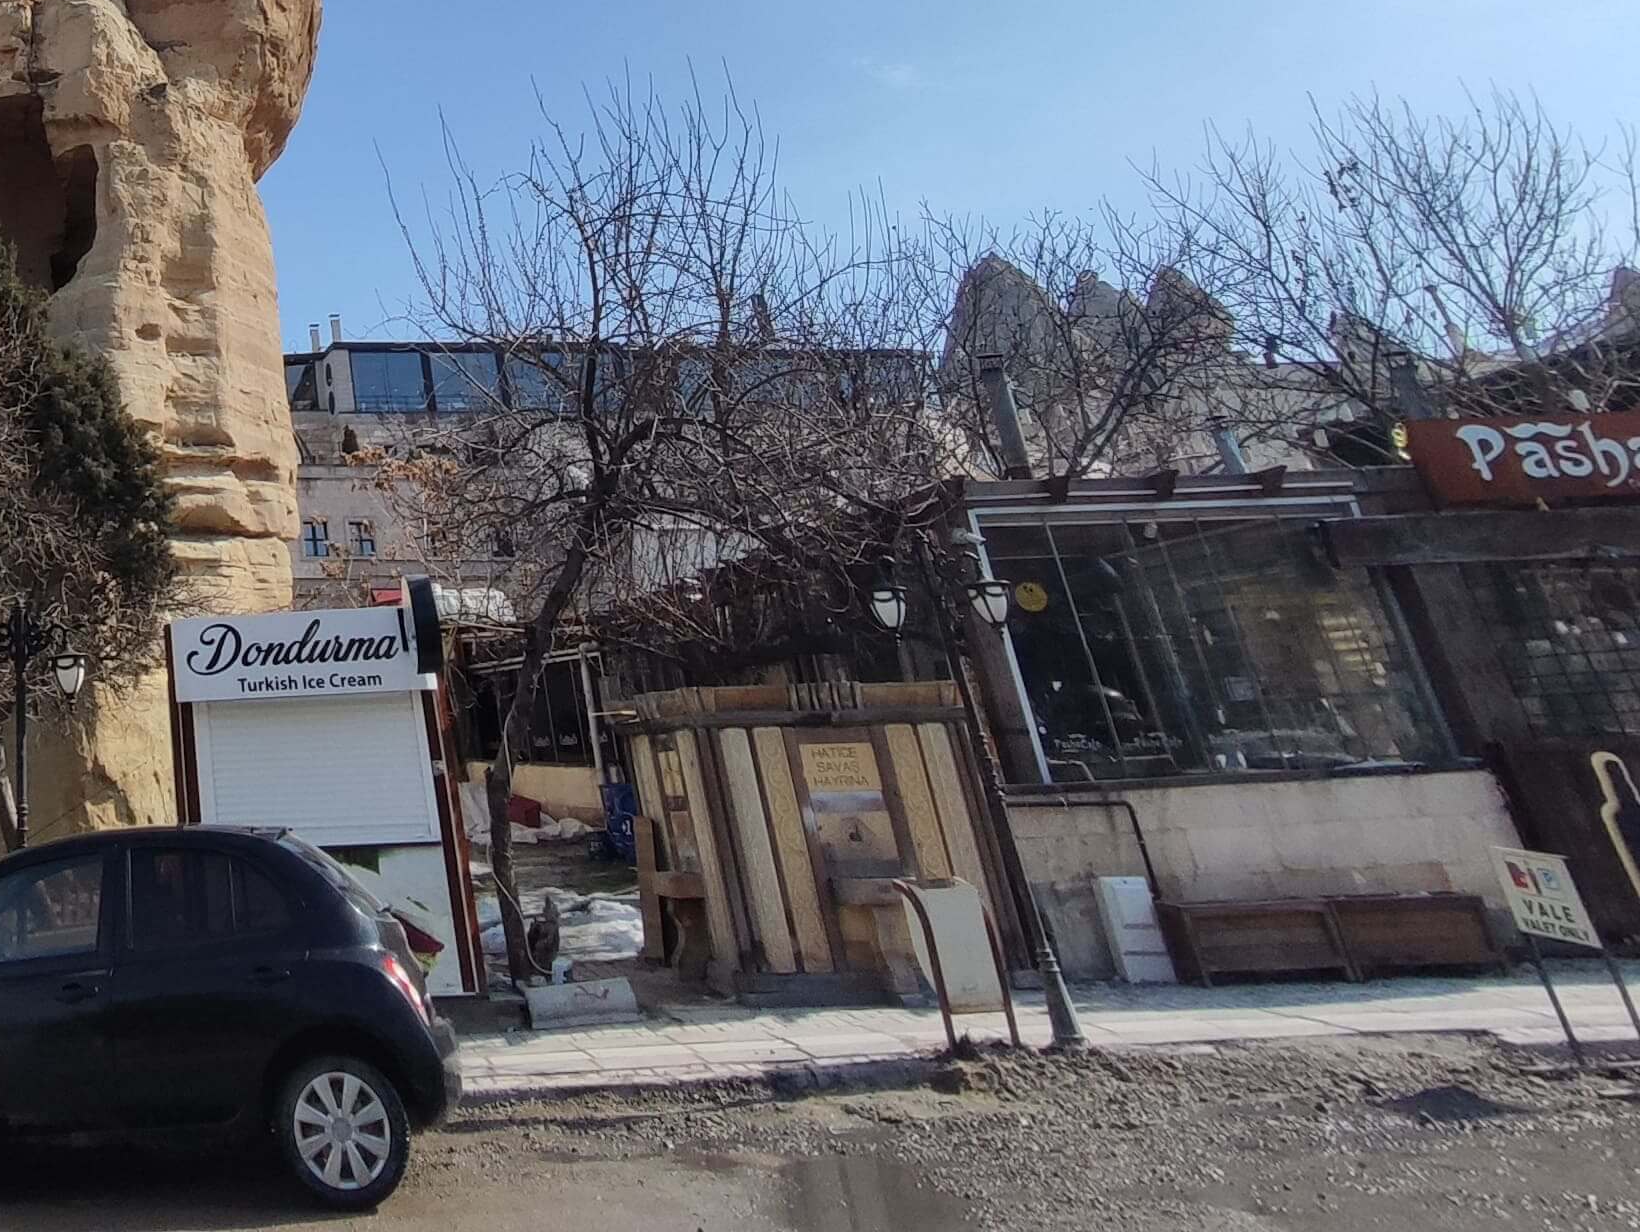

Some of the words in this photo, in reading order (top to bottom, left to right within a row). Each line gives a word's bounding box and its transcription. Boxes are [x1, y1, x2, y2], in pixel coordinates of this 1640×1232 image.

[1456, 421, 1640, 487] Pash
[186, 618, 399, 676] Dondurma
[238, 676, 298, 693] Turkish
[302, 675, 325, 689] Ice
[329, 672, 383, 688] Cream
[1521, 898, 1576, 924] VALE
[1521, 917, 1557, 935] VALET
[1559, 924, 1591, 943] ONLY
